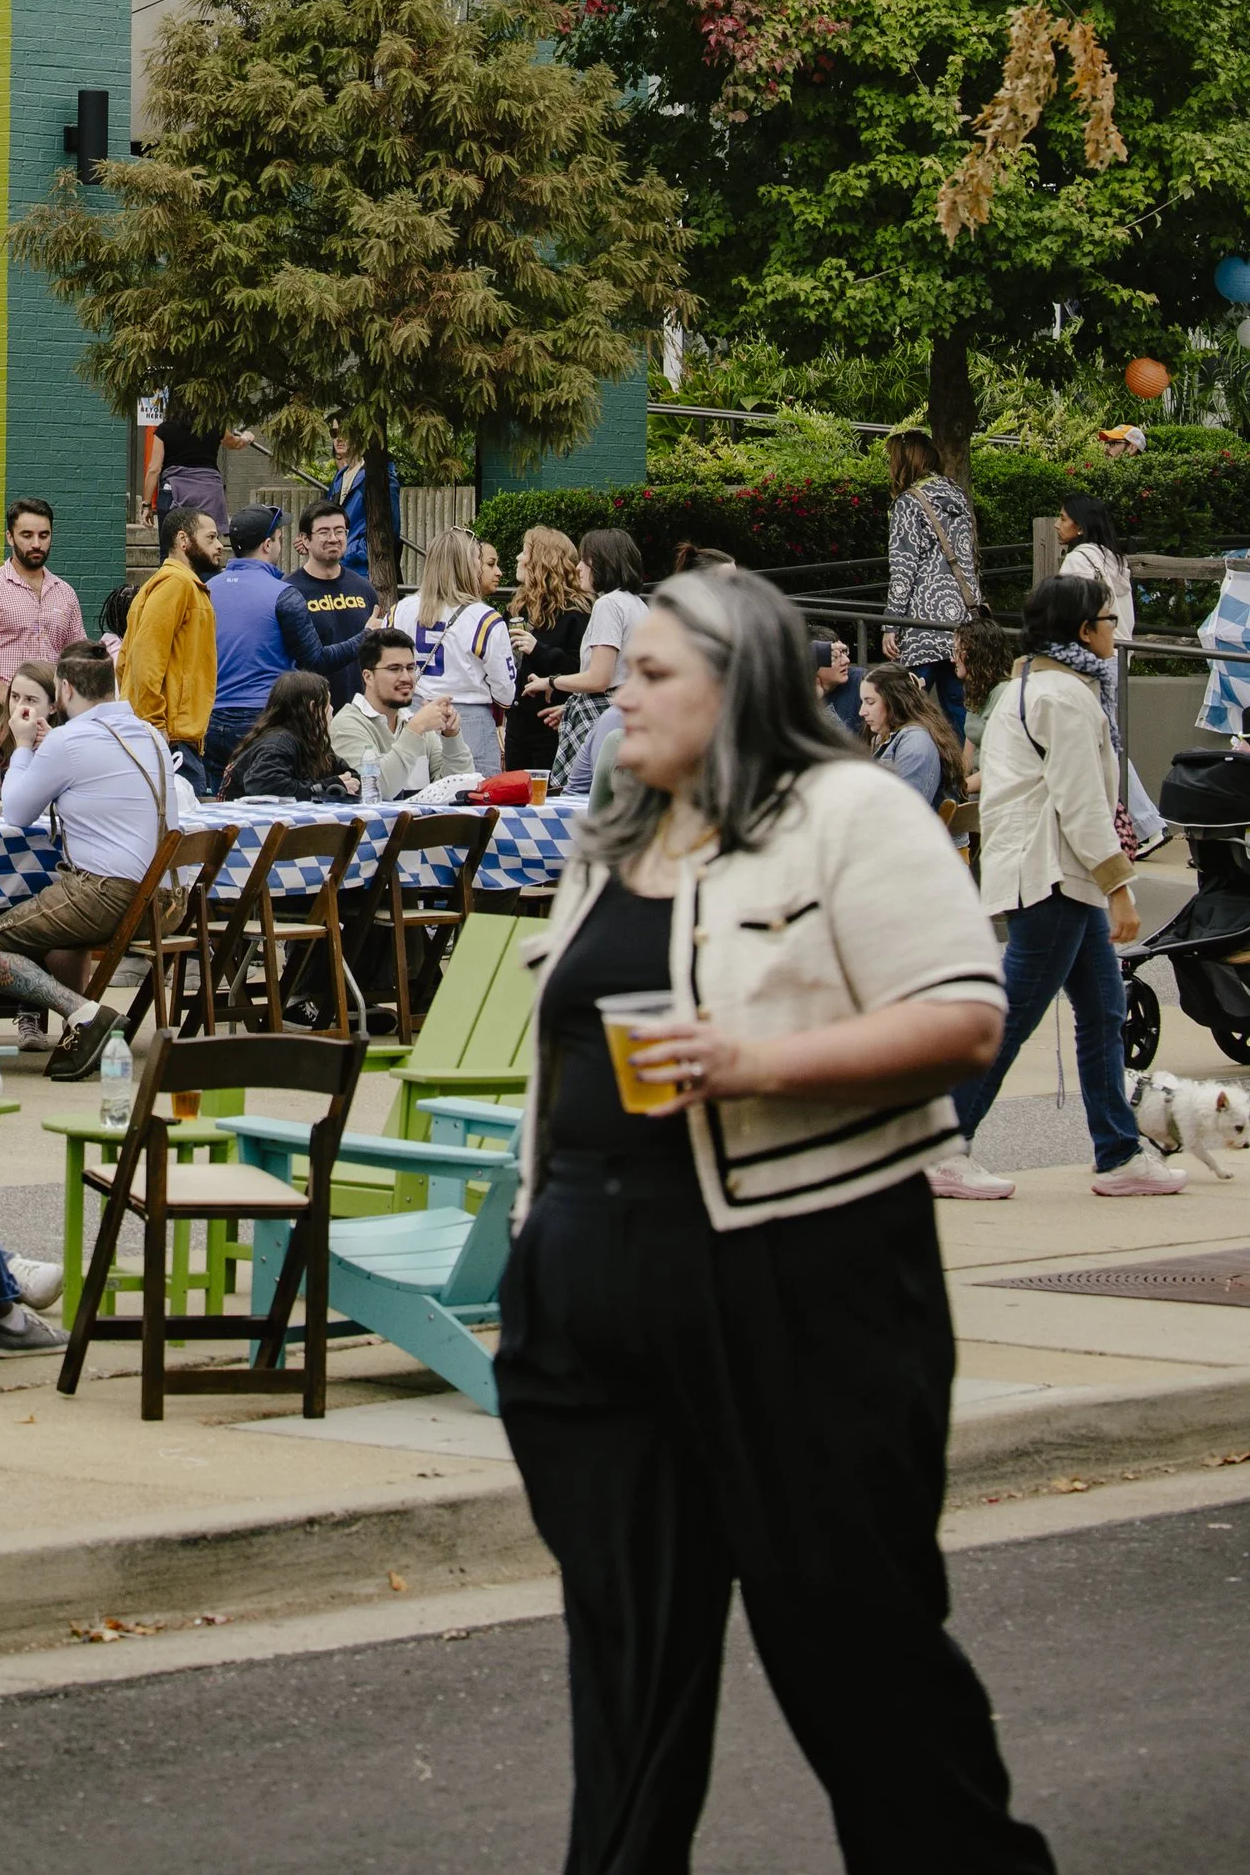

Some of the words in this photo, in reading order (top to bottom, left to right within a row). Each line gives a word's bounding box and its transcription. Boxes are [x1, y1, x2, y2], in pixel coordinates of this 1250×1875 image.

[306, 592, 367, 613] adidas
[415, 620, 447, 677] 5
[505, 656, 516, 681] 5
